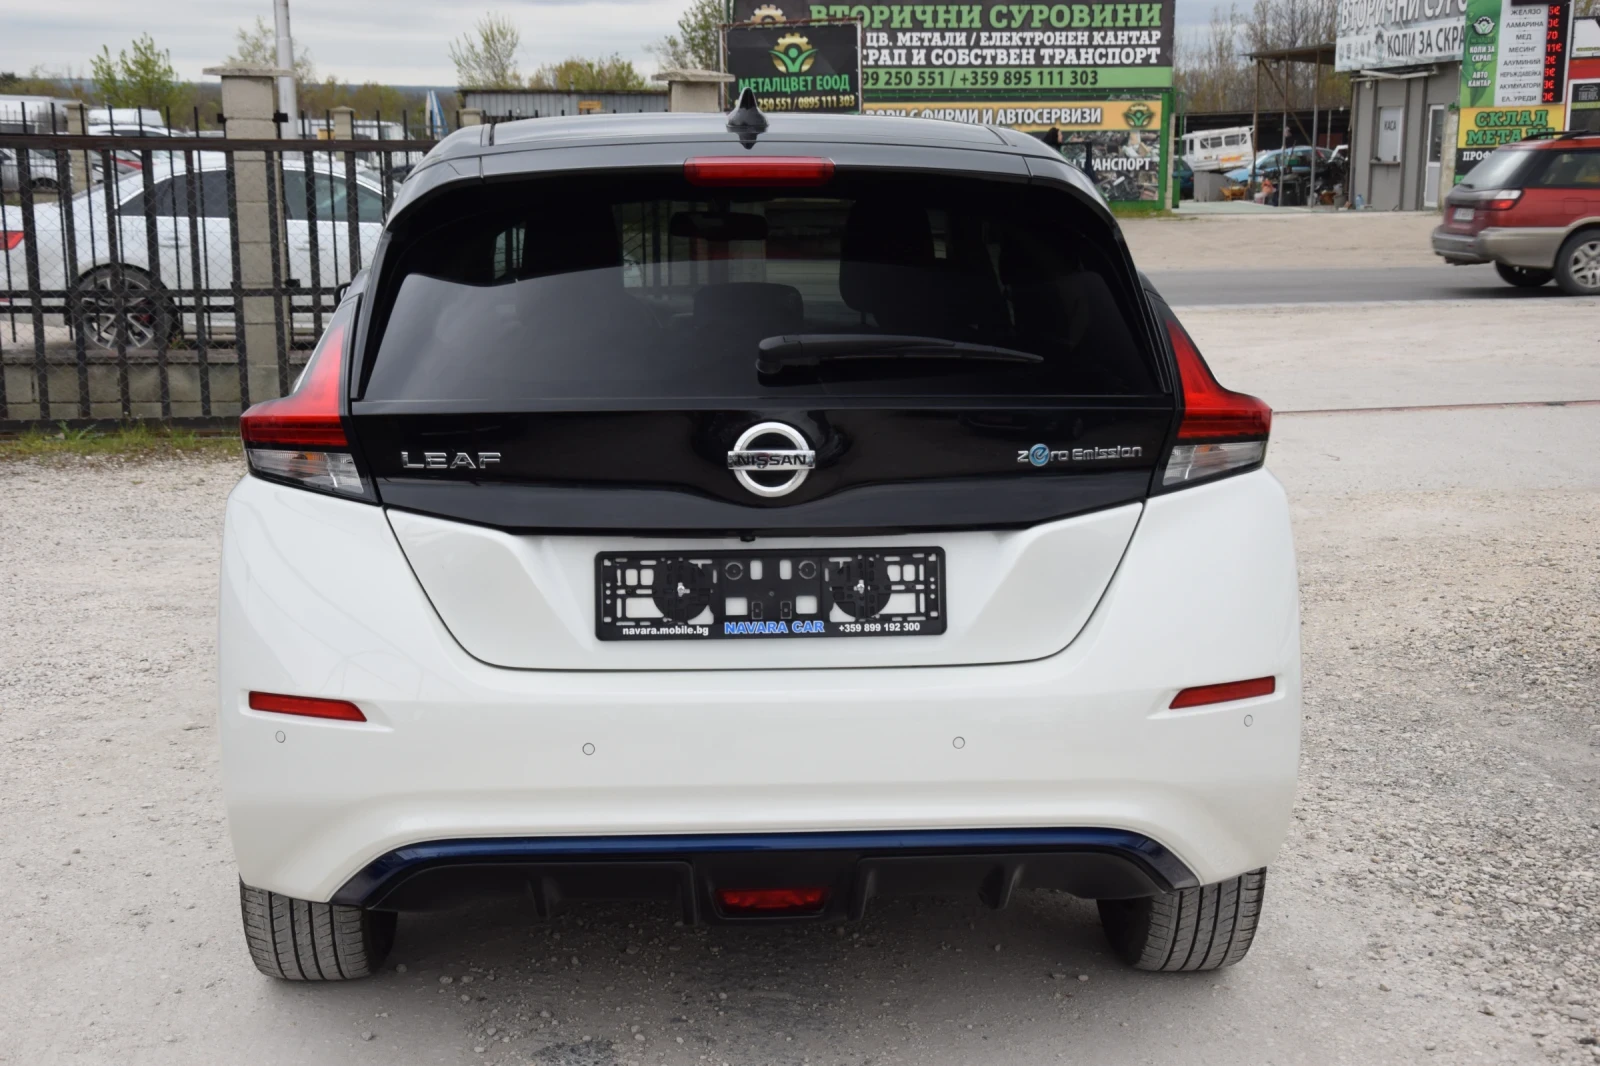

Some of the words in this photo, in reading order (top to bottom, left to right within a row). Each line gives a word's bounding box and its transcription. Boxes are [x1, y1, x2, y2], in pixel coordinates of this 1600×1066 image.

[810, 5, 982, 28] ВТОРИЧНИ
[989, 4, 1162, 28] СУРОВИНИ
[866, 32, 893, 48] ЦВ.
[897, 32, 967, 47] МЕТАЛИ
[970, 32, 977, 47] /
[980, 31, 1089, 46] ЕЛЕКТРОНЕН
[1092, 30, 1161, 46] КАНТАР
[1387, 32, 1416, 57] КОЛИ
[1419, 29, 1433, 54] ЗА
[863, 49, 907, 66] РАП
[912, 49, 926, 65] И
[931, 48, 1035, 66] СОБСТВЕН
[1040, 47, 1160, 65] ТРАНСПОРТ
[738, 76, 813, 94] МЕТАЛЦВЕТ
[816, 74, 850, 92] ЕООД
[884, 71, 913, 86] 250
[917, 71, 945, 86] 551
[950, 70, 957, 87] /
[960, 71, 999, 86] +359
[1003, 71, 1031, 86] 895
[1038, 70, 1064, 86] 111
[1070, 70, 1098, 86] 303
[758, 98, 774, 111] 250
[775, 98, 791, 110] 551
[798, 96, 819, 109] 0895
[821, 95, 837, 108] 111
[839, 95, 855, 107] 303
[982, 109, 993, 125] И
[996, 108, 1102, 126] АВТОСЕРВИЗИ
[1475, 110, 1548, 127] СКЛАД
[1081, 157, 1151, 172] ТАНСПОРТ
[401, 451, 502, 469] LEAF
[736, 454, 807, 466] NISSAN
[1072, 445, 1142, 461] Emission
[622, 625, 709, 636] navara.mobile.bg
[724, 621, 788, 635] NAVARA
[792, 620, 825, 634] CAR
[839, 623, 862, 633] +359
[863, 623, 881, 632] 899
[883, 623, 901, 632] 192
[903, 622, 921, 631] 300
